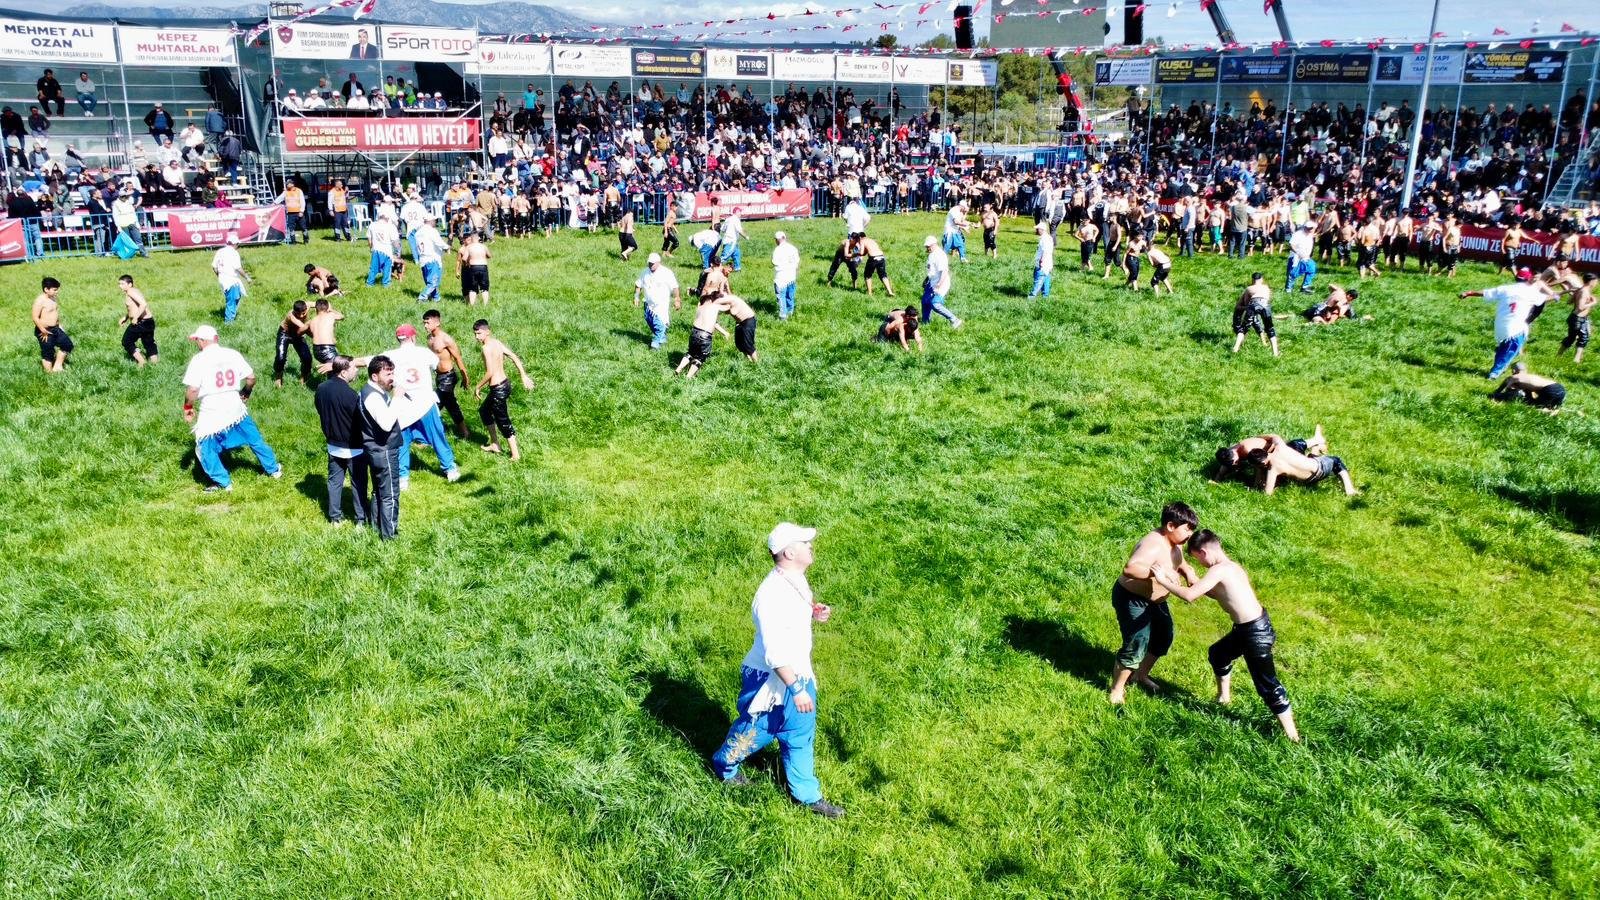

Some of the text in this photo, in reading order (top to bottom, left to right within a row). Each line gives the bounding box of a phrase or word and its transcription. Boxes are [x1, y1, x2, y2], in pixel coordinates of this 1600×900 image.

[4, 25, 94, 38] MEHMET ALİ
[157, 33, 198, 42] KEPEZ
[31, 38, 73, 48] OZAN
[137, 43, 220, 53] MUHTARLARI
[738, 60, 766, 68] MYROS
[1306, 61, 1340, 71] OSTİMA
[364, 121, 469, 146] HAKEM HEYETİ
[215, 369, 235, 388] 89
[406, 368, 420, 384] 3
